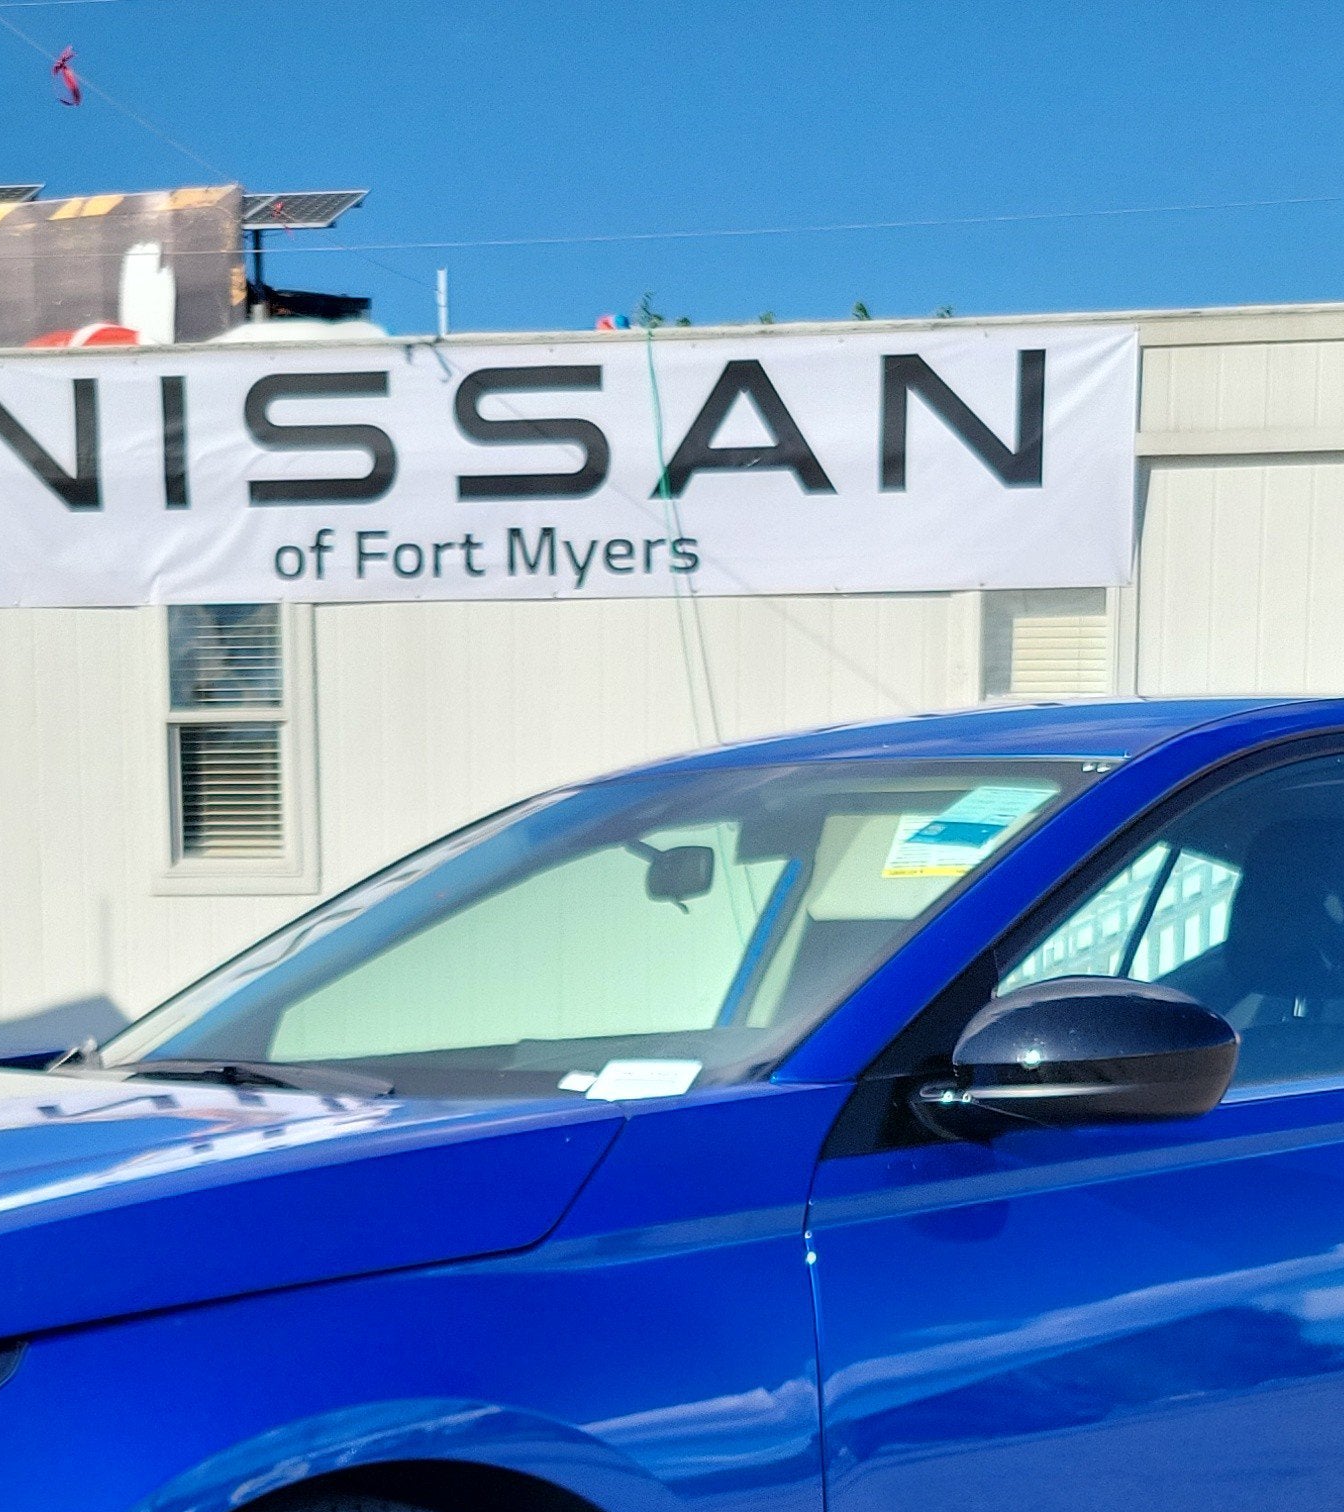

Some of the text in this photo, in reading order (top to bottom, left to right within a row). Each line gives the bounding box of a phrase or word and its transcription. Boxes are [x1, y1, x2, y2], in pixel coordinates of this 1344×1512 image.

[273, 526, 701, 588] of Fort Myers
